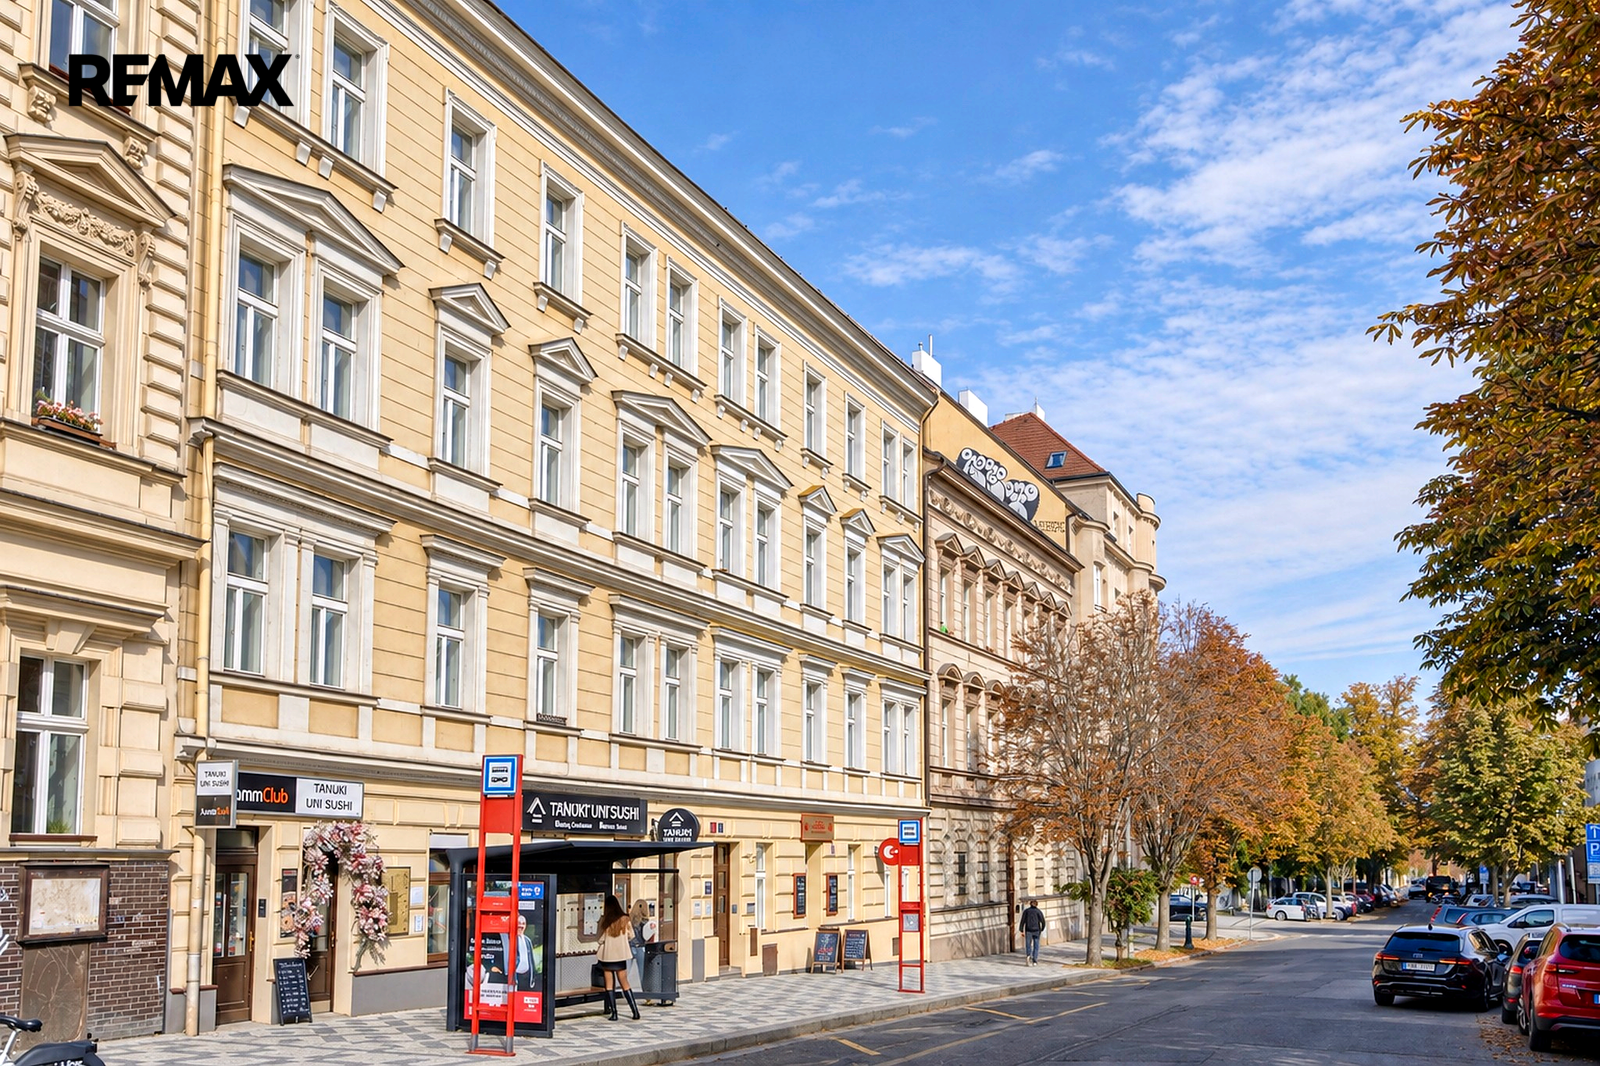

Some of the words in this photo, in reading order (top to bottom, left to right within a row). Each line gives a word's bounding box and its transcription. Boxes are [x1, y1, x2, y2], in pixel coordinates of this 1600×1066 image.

[313, 783, 347, 795] TANUKI
[306, 798, 322, 809] UNI
[325, 799, 353, 811] SUSHI
[610, 805, 640, 821] SUSHI
